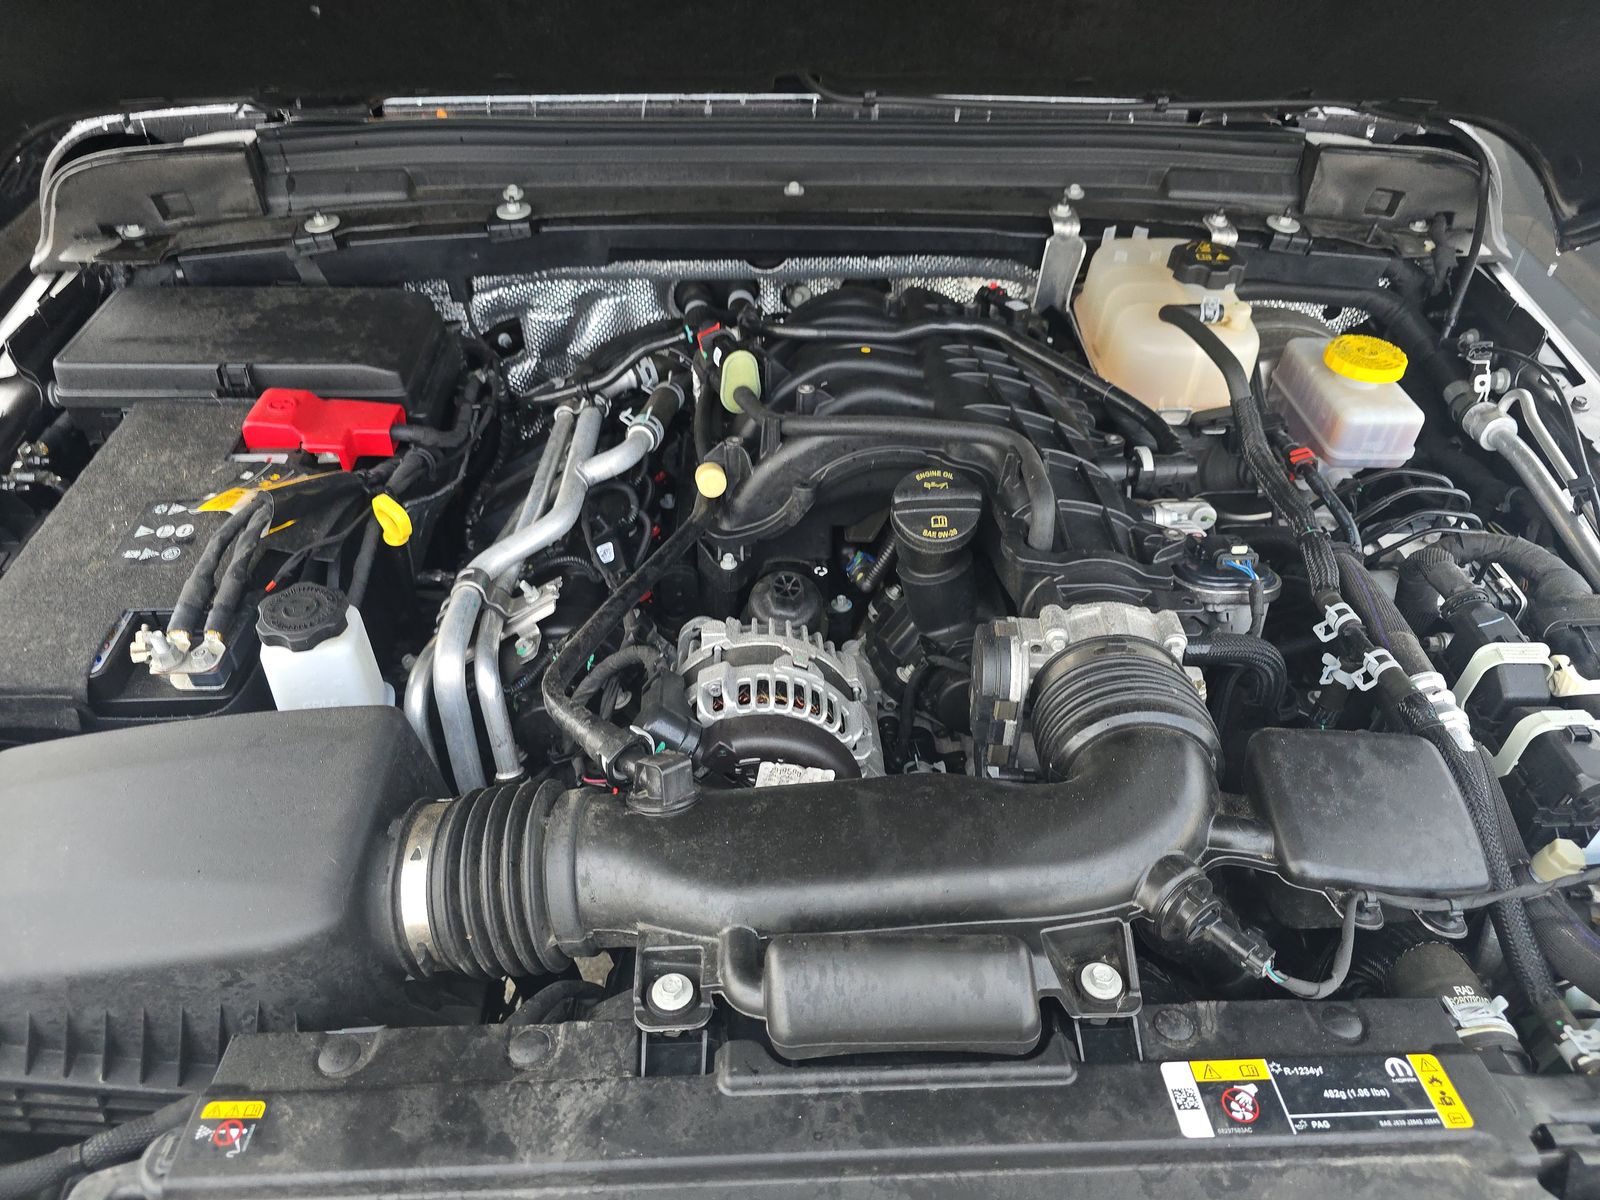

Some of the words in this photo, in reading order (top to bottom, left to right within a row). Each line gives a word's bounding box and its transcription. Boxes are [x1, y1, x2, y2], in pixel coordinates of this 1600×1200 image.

[915, 470, 942, 481] ENGINE
[942, 470, 954, 480] OIL
[922, 529, 937, 539] SAE
[1453, 985, 1475, 996] RAD
[1283, 1066, 1324, 1077] R-1234yf
[1323, 1088, 1347, 1100] 482g
[1311, 1120, 1331, 1129] PAG
